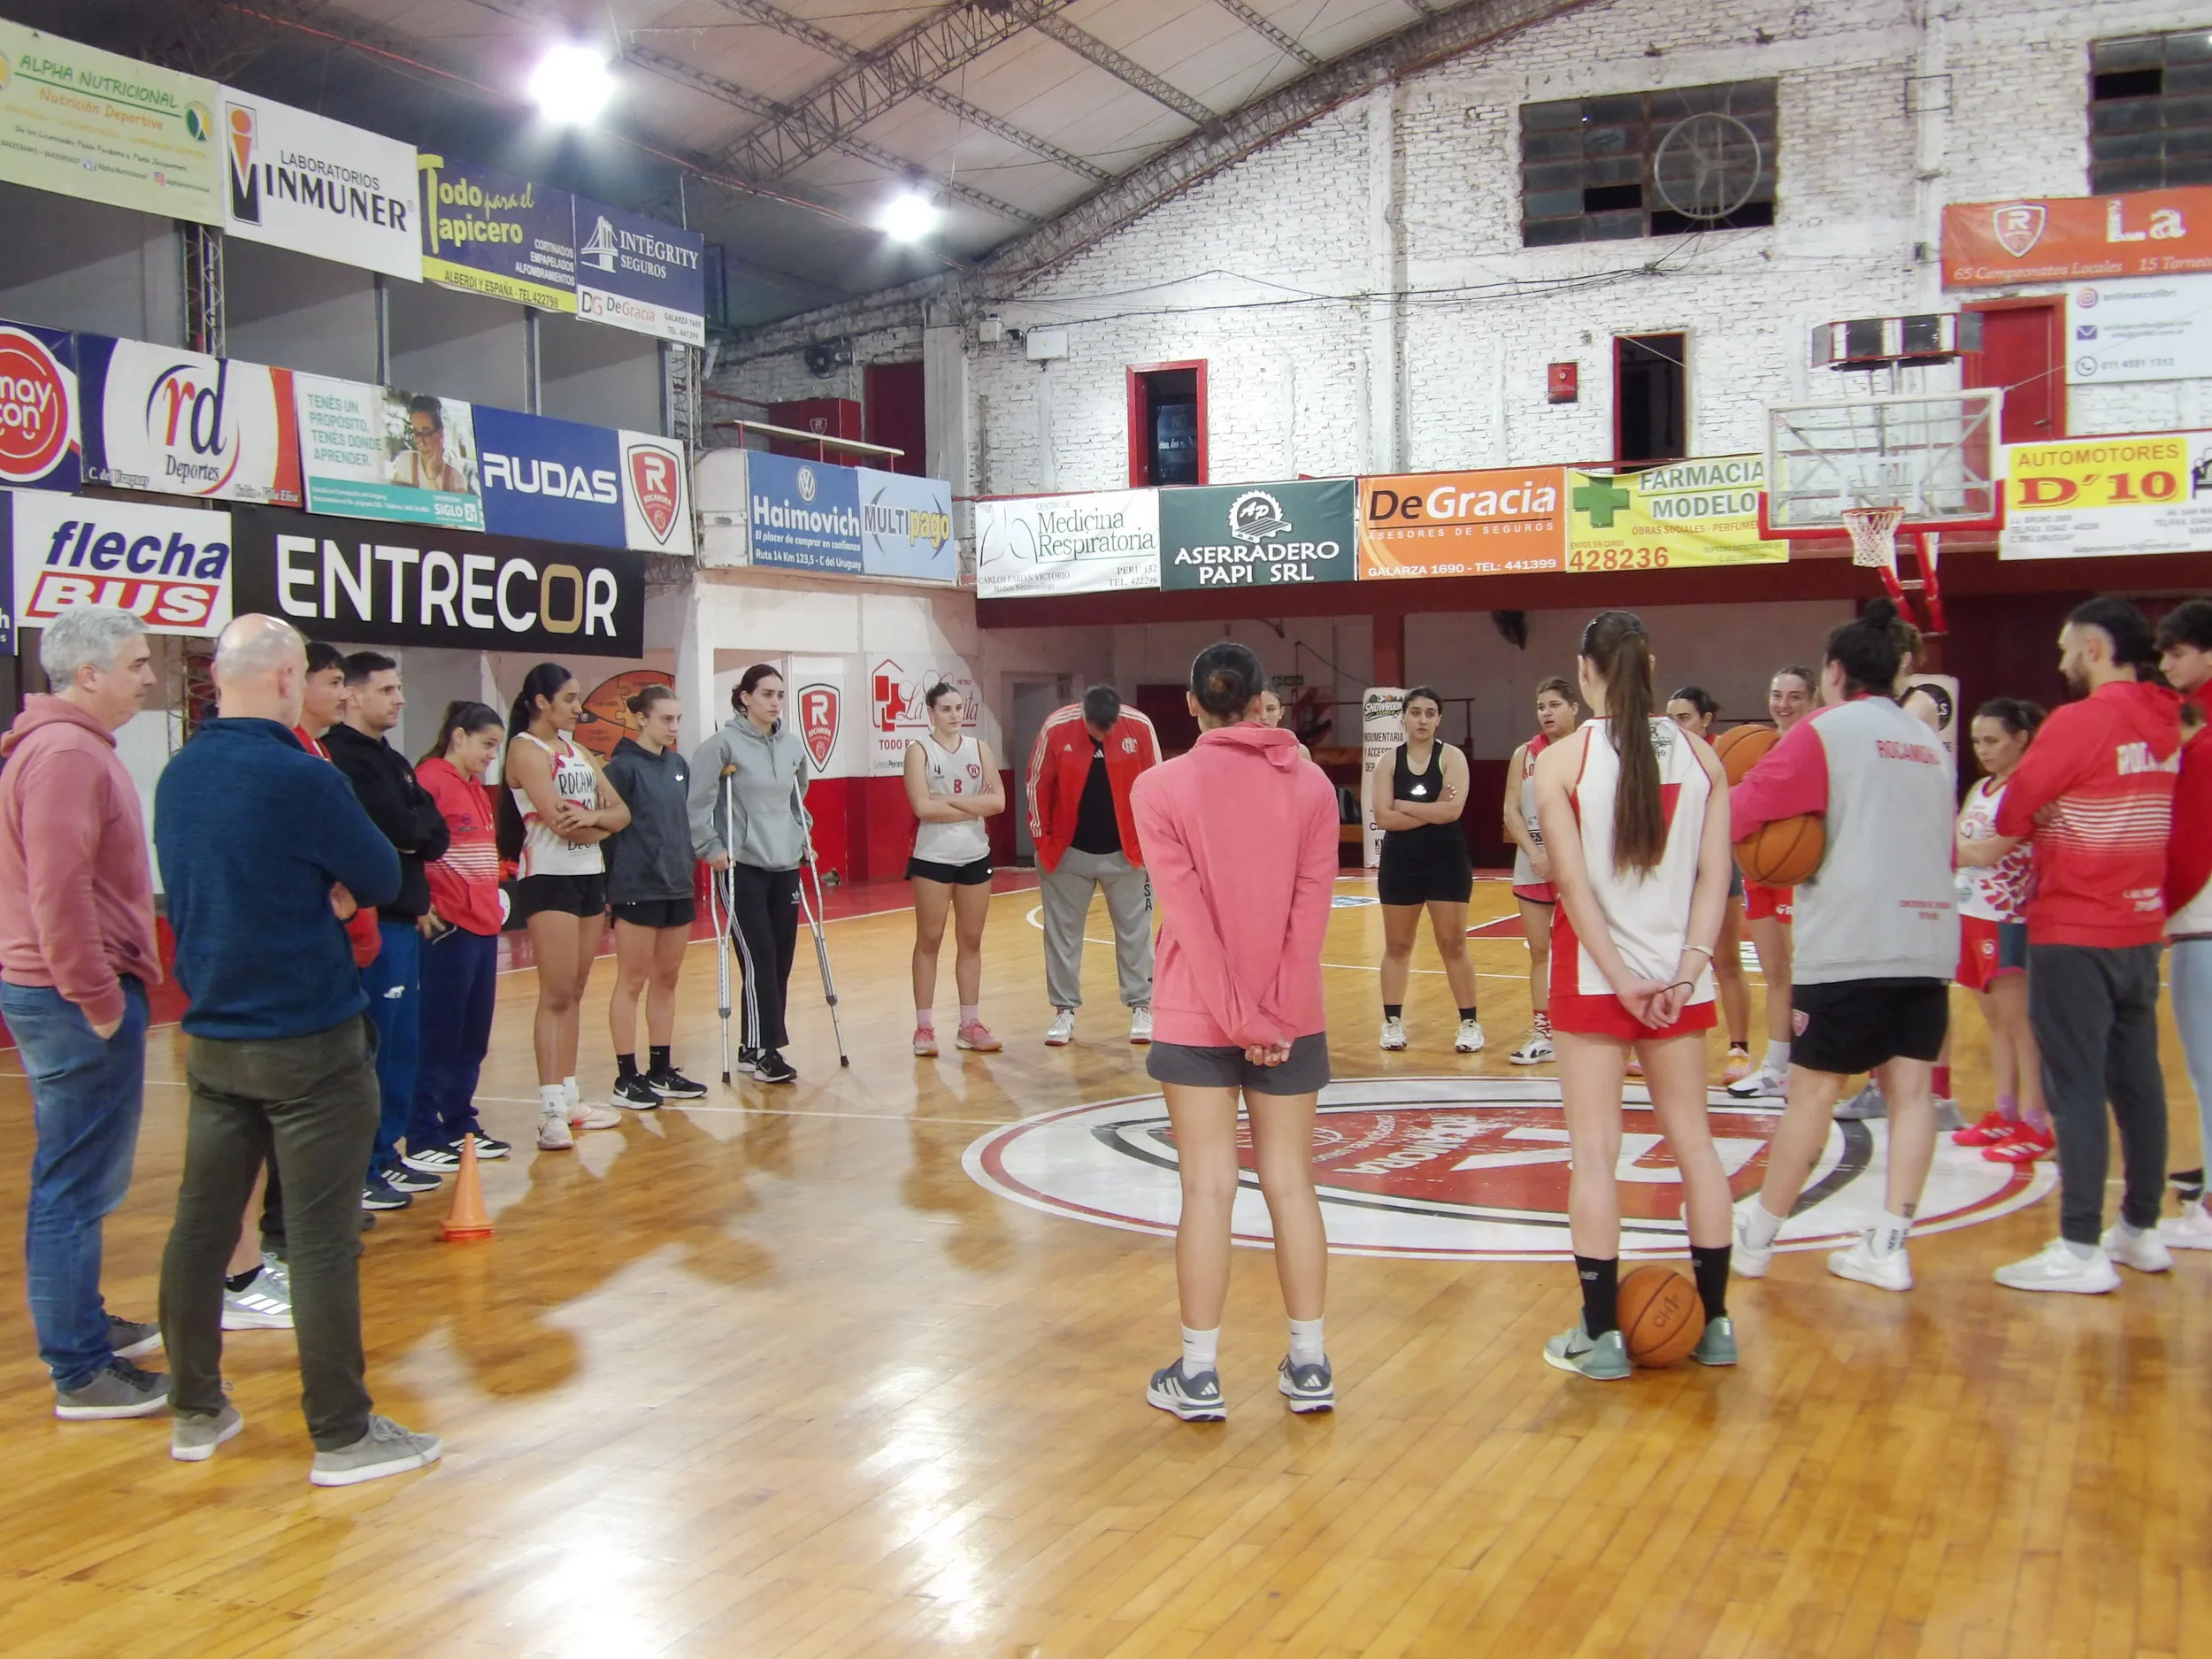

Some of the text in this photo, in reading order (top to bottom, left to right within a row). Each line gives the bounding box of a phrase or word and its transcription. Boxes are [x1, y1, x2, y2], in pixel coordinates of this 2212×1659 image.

[20, 53, 179, 109] ALPHA NUTRICIONAL
[39, 88, 165, 130] Nutrición Deportiva
[280, 149, 380, 191] LABORATORIOS
[265, 163, 407, 233] INMUNER
[520, 181, 535, 209] el
[2107, 199, 2188, 243] La
[534, 238, 574, 258] CORTINADOS
[515, 262, 575, 287] ALFOMBRAMIENTOS
[530, 251, 574, 273] EMPAPELADOS
[620, 254, 667, 279] SEGUROS
[1954, 267, 1973, 280] 65
[1974, 265, 2069, 281] Campeonatos
[2071, 259, 2124, 274] Locales
[2139, 257, 2159, 272] 15
[444, 270, 476, 288] ALBERDI
[476, 279, 484, 289] Y
[486, 280, 514, 298] ESPAÑA
[533, 291, 559, 309] 422798
[581, 290, 603, 317] DG
[163, 357, 229, 457] rd
[307, 392, 359, 414] TENÉS UN
[311, 429, 346, 445] TENÉS
[314, 448, 373, 467] APRENDER.
[2018, 444, 2180, 467] AUTOMOTORES
[165, 454, 220, 483] Deportes
[483, 451, 618, 504] RUDAS
[643, 456, 668, 494] R
[1640, 460, 1764, 491] FARMACIA
[434, 503, 464, 518] SIGLO
[753, 495, 861, 538] Haimovich
[1240, 501, 1270, 520] AP
[1652, 492, 1756, 518] MODELO
[1037, 508, 1126, 534] Medicina
[1368, 522, 1554, 540] ASESORES DE SEGUROS
[1632, 526, 1662, 535] OBRAS
[1663, 524, 1706, 534] SOCIALES
[45, 520, 231, 580] flecha
[755, 530, 761, 540] El
[763, 531, 784, 543] placer
[785, 534, 794, 544] de
[795, 536, 822, 549] comprar
[832, 539, 862, 552] confianza
[1038, 527, 1156, 561] Respiratoria
[1174, 541, 1340, 565] ASERRADERO
[756, 549, 772, 560] Ruta
[773, 550, 782, 561] 14
[783, 551, 795, 563] Km
[795, 553, 815, 566] 123,5
[819, 556, 825, 566] C
[825, 556, 835, 566] del
[835, 557, 862, 572] Uruguay
[1368, 565, 1427, 577] GALARZA
[1431, 563, 1464, 574] 1690
[1474, 562, 1502, 572] TEL:
[1504, 558, 1556, 571] 441399
[1570, 546, 1670, 571] 428236
[275, 533, 618, 637] ENTRECOR
[979, 575, 1007, 584] CARLOS
[1033, 571, 1071, 581] VICTORIO
[1130, 576, 1158, 586] 422296
[1199, 563, 1315, 585] PAPI SRL
[34, 575, 211, 622] BUS
[810, 694, 829, 726] R
[879, 739, 902, 749] TODO
